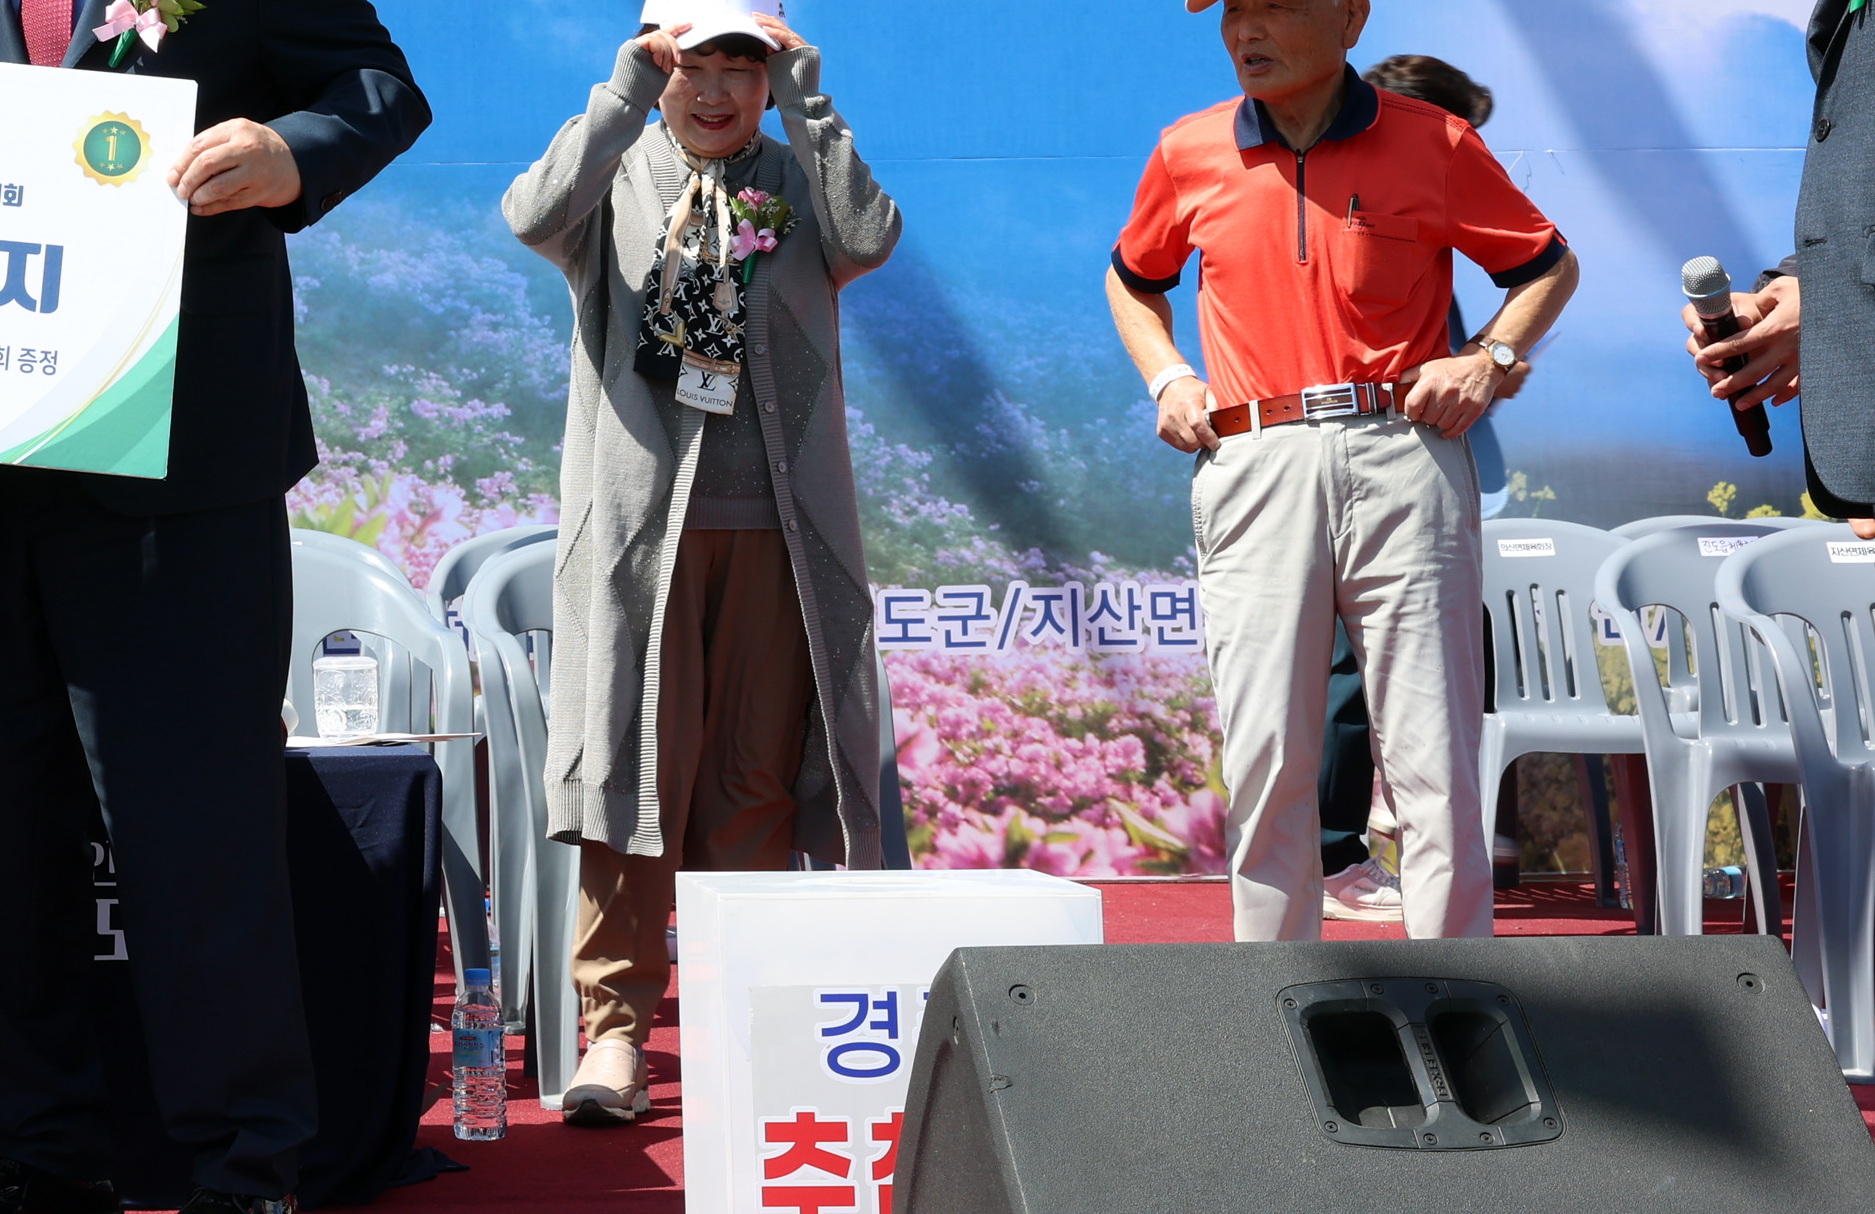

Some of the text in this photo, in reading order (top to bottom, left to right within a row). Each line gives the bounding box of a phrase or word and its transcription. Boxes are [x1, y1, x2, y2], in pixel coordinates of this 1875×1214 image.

[18, 348, 60, 376] 증정
[676, 388, 733, 408] LOUIS VUITTON
[819, 990, 929, 1078] 경
